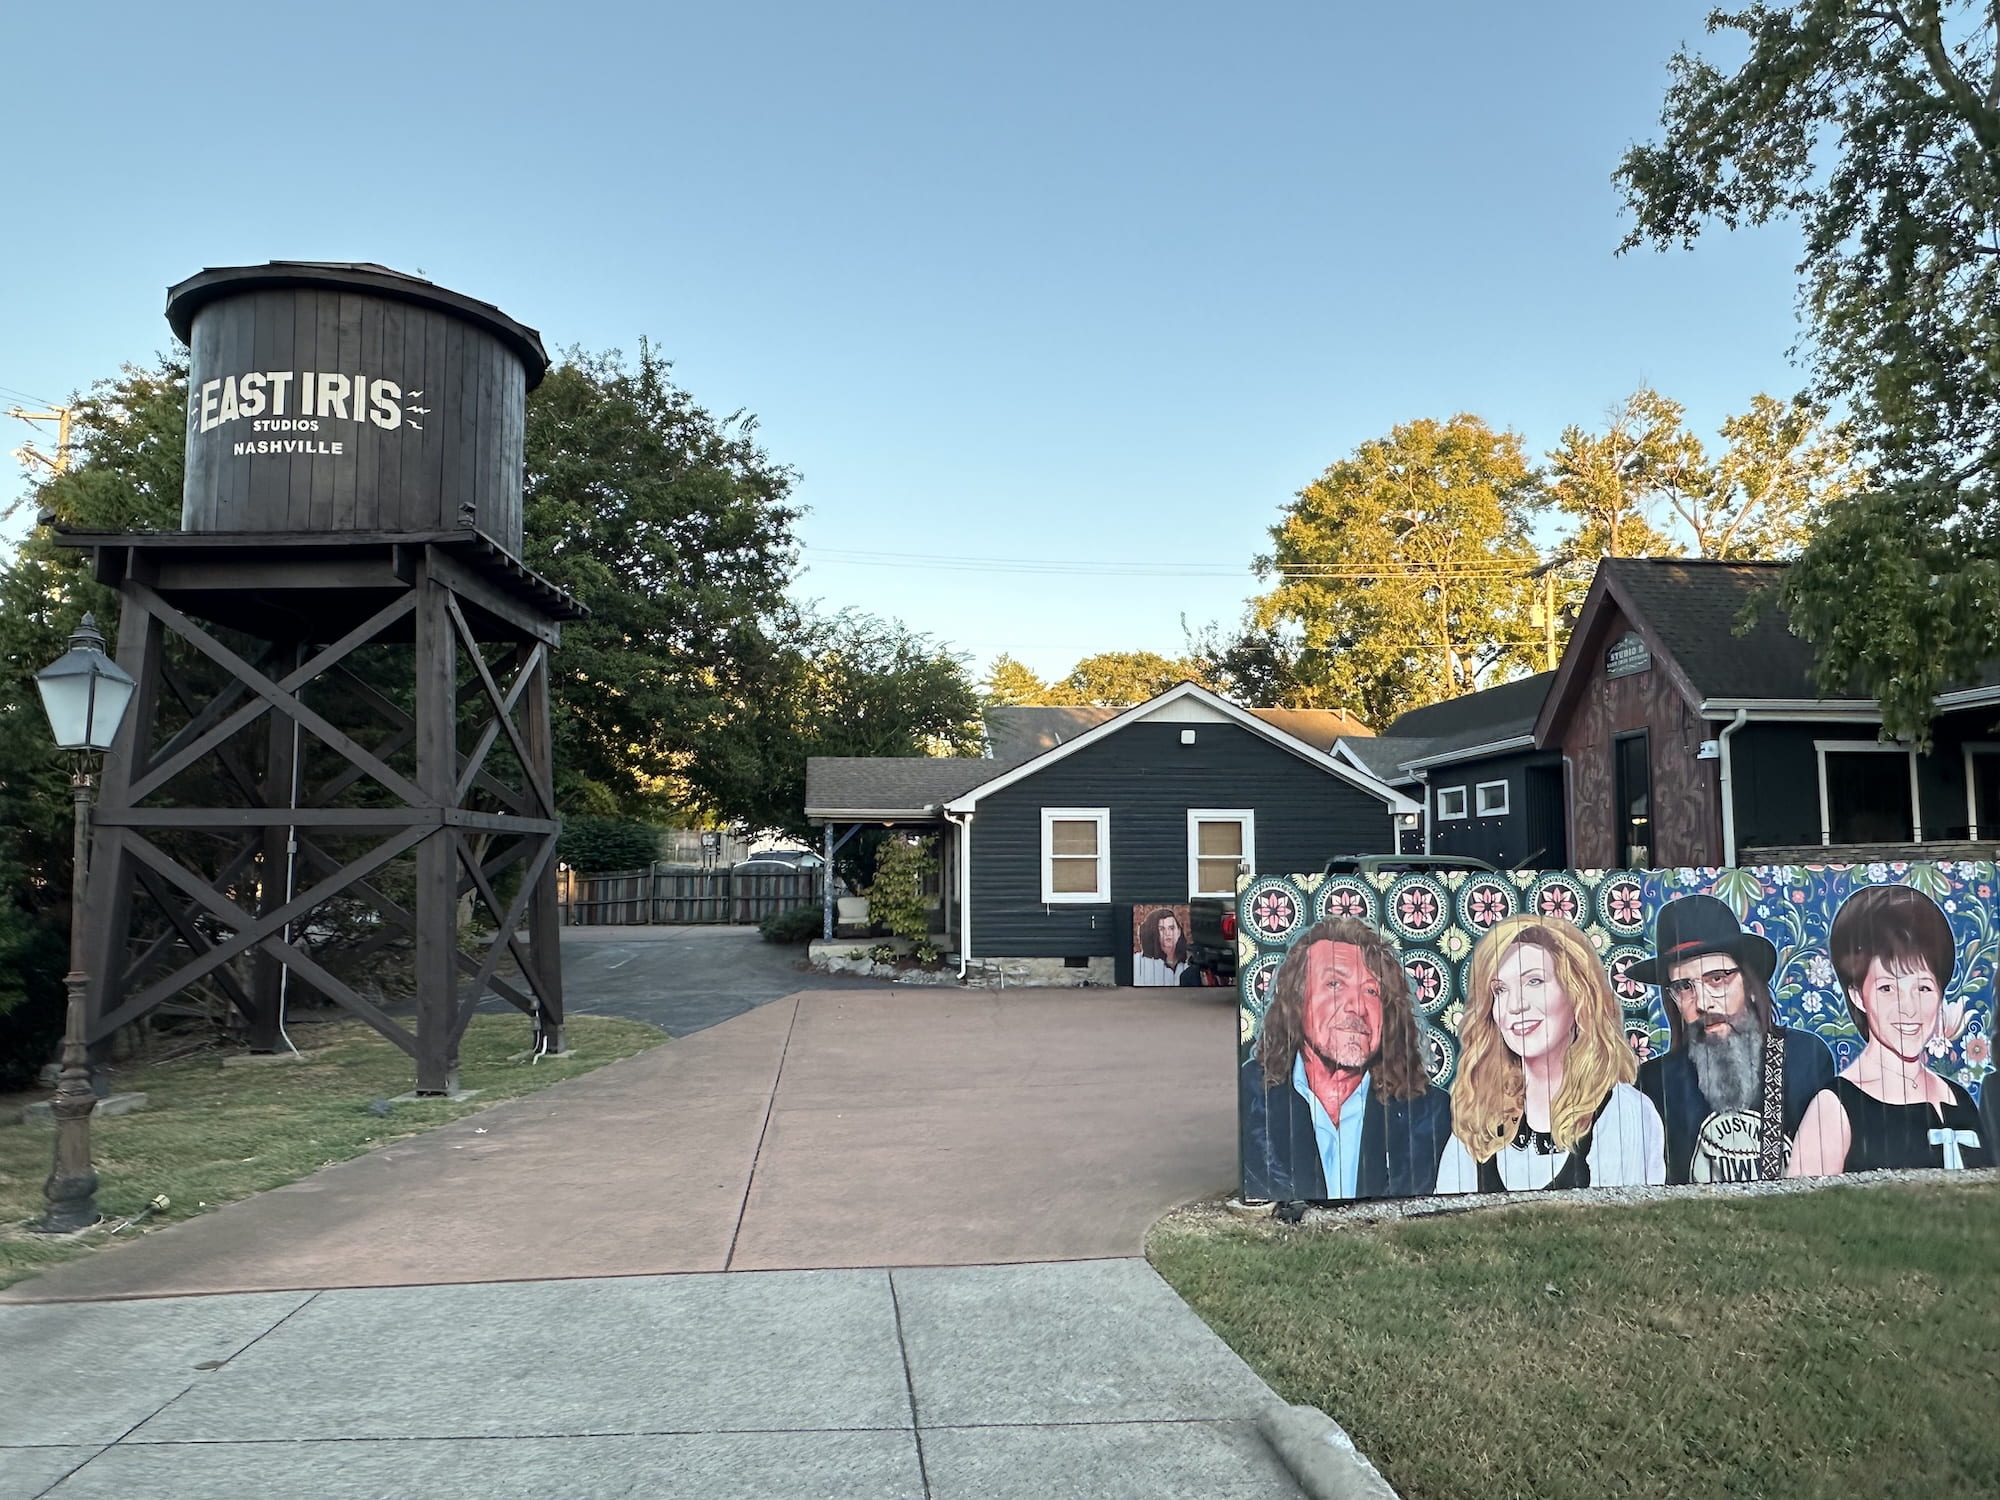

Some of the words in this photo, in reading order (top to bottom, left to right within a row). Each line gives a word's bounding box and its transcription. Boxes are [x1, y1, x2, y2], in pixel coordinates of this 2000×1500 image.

[200, 371, 293, 434] EAST
[302, 371, 402, 432] IRIS
[253, 419, 319, 432] STUDIOS
[233, 440, 344, 456] NASHVILLE
[1610, 647, 1637, 661] STUDIO
[1715, 1117, 1761, 1141] JUSTIN
